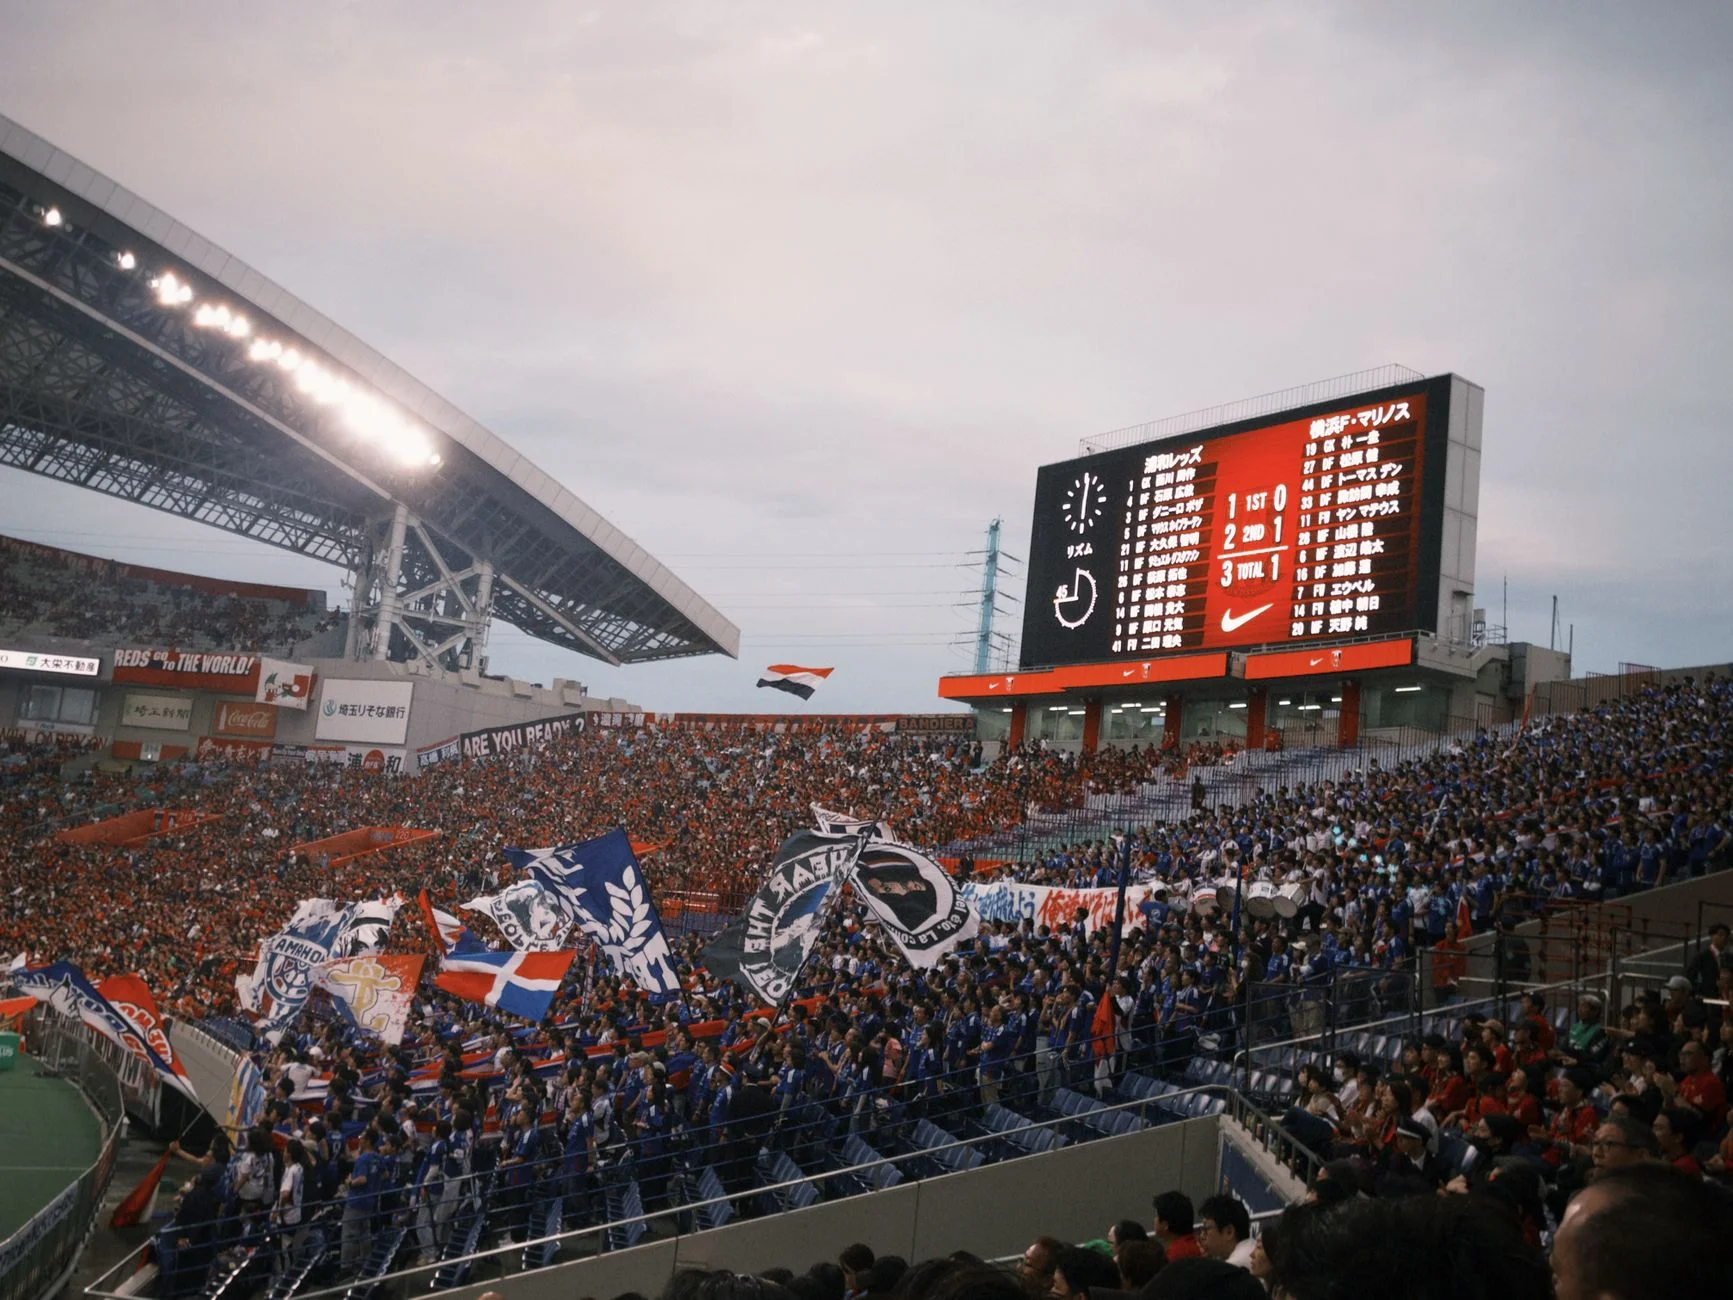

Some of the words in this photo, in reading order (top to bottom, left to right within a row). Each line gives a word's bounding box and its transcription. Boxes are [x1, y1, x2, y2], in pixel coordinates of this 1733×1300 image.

[1309, 402, 1411, 440] 横浜F・マリノス
[1305, 442, 1317, 457] 19
[1143, 445, 1204, 475] 浦和レッズ
[1303, 460, 1316, 475] 27
[1301, 478, 1315, 492] 44
[1338, 466, 1378, 487] トーマス
[1380, 462, 1403, 479] デン
[1129, 479, 1134, 492] 1
[1126, 495, 1133, 508] 4
[1228, 492, 1237, 520] 1
[1245, 491, 1268, 512] 1ST
[1273, 483, 1287, 512] 0
[1300, 495, 1313, 511] 33
[1125, 511, 1132, 524] 3
[1300, 513, 1311, 528] 11
[1335, 507, 1357, 522] ヤン
[1358, 499, 1400, 518] マテウス
[1123, 527, 1131, 540] 5
[1223, 522, 1236, 550] 2
[1241, 523, 1265, 544] 2ND
[1273, 515, 1283, 543] 1
[1067, 542, 1093, 559] リズム
[1120, 543, 1131, 556] 21
[1299, 549, 1307, 564] 6
[1120, 559, 1129, 572] 11
[1220, 560, 1234, 588] 3
[1236, 560, 1265, 581] TOTAL
[1270, 553, 1280, 581] 1
[1296, 567, 1308, 582] 16
[1056, 583, 1069, 598] 45
[1297, 586, 1304, 600] 7
[1330, 578, 1375, 596] エウベル
[1118, 591, 1125, 604] 6
[1115, 606, 1126, 620] 14
[1294, 603, 1306, 618] 14
[1291, 621, 1305, 636] 20
[1111, 640, 1122, 653] 41
[40, 657, 96, 673] 大栄不動産
[113, 649, 150, 668] REDS
[153, 652, 168, 662] GO
[162, 660, 176, 671] TO
[176, 653, 201, 673] THE
[201, 655, 255, 676] WORLD!
[338, 703, 406, 720] 埼玉りそな銀行
[898, 717, 975, 731] BANDIERA
[463, 732, 491, 758] ARE
[491, 730, 522, 751] YOU
